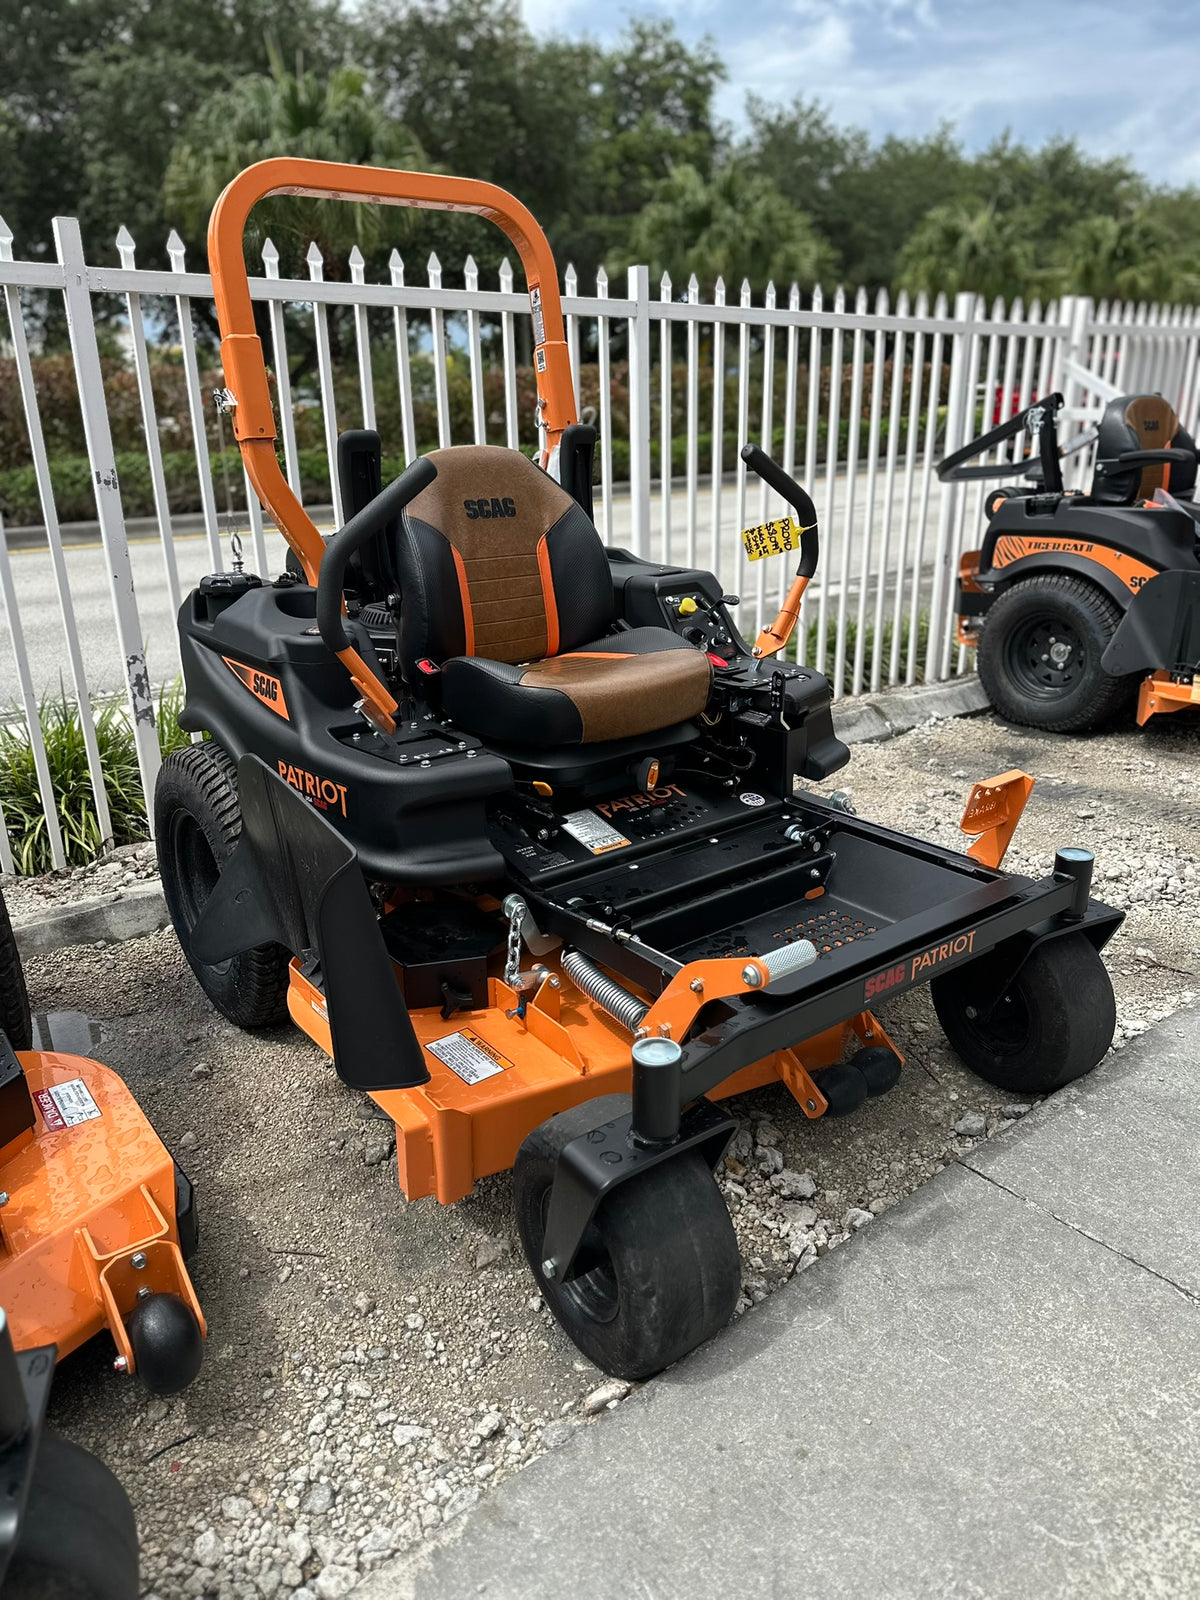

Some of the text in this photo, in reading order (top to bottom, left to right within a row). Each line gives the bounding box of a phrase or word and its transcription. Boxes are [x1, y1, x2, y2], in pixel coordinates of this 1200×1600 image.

[463, 498, 517, 520] SCAG
[1028, 541, 1061, 551] TIGER
[1129, 576, 1151, 588] SC
[253, 673, 278, 701] SCAG
[277, 760, 347, 818] PATRIOT
[595, 784, 688, 818] PATRIOT
[865, 930, 976, 998] SCAG PATRIOT
[475, 1040, 502, 1061] WARNING
[38, 1093, 57, 1119] DANGER
